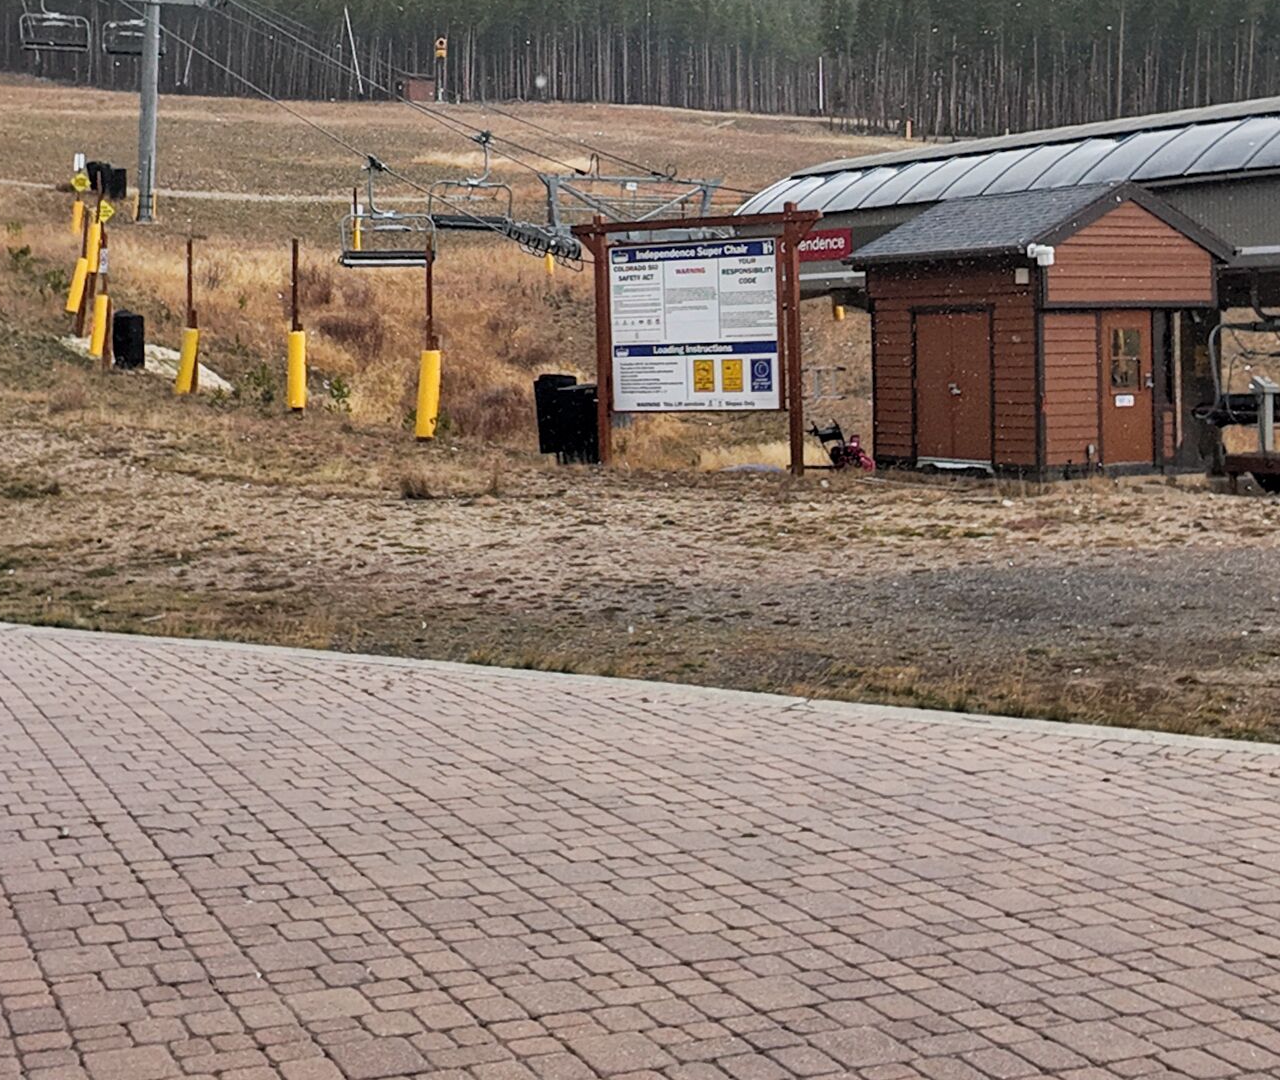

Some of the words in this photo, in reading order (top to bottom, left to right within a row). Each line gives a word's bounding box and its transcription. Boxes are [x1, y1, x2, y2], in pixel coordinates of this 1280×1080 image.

[635, 247, 695, 260] Independence
[696, 245, 722, 257] Super
[723, 243, 748, 254] Chair
[613, 264, 647, 272] COLORADO
[721, 266, 774, 275] RESPONSIBILITY
[652, 345, 684, 355] Loading
